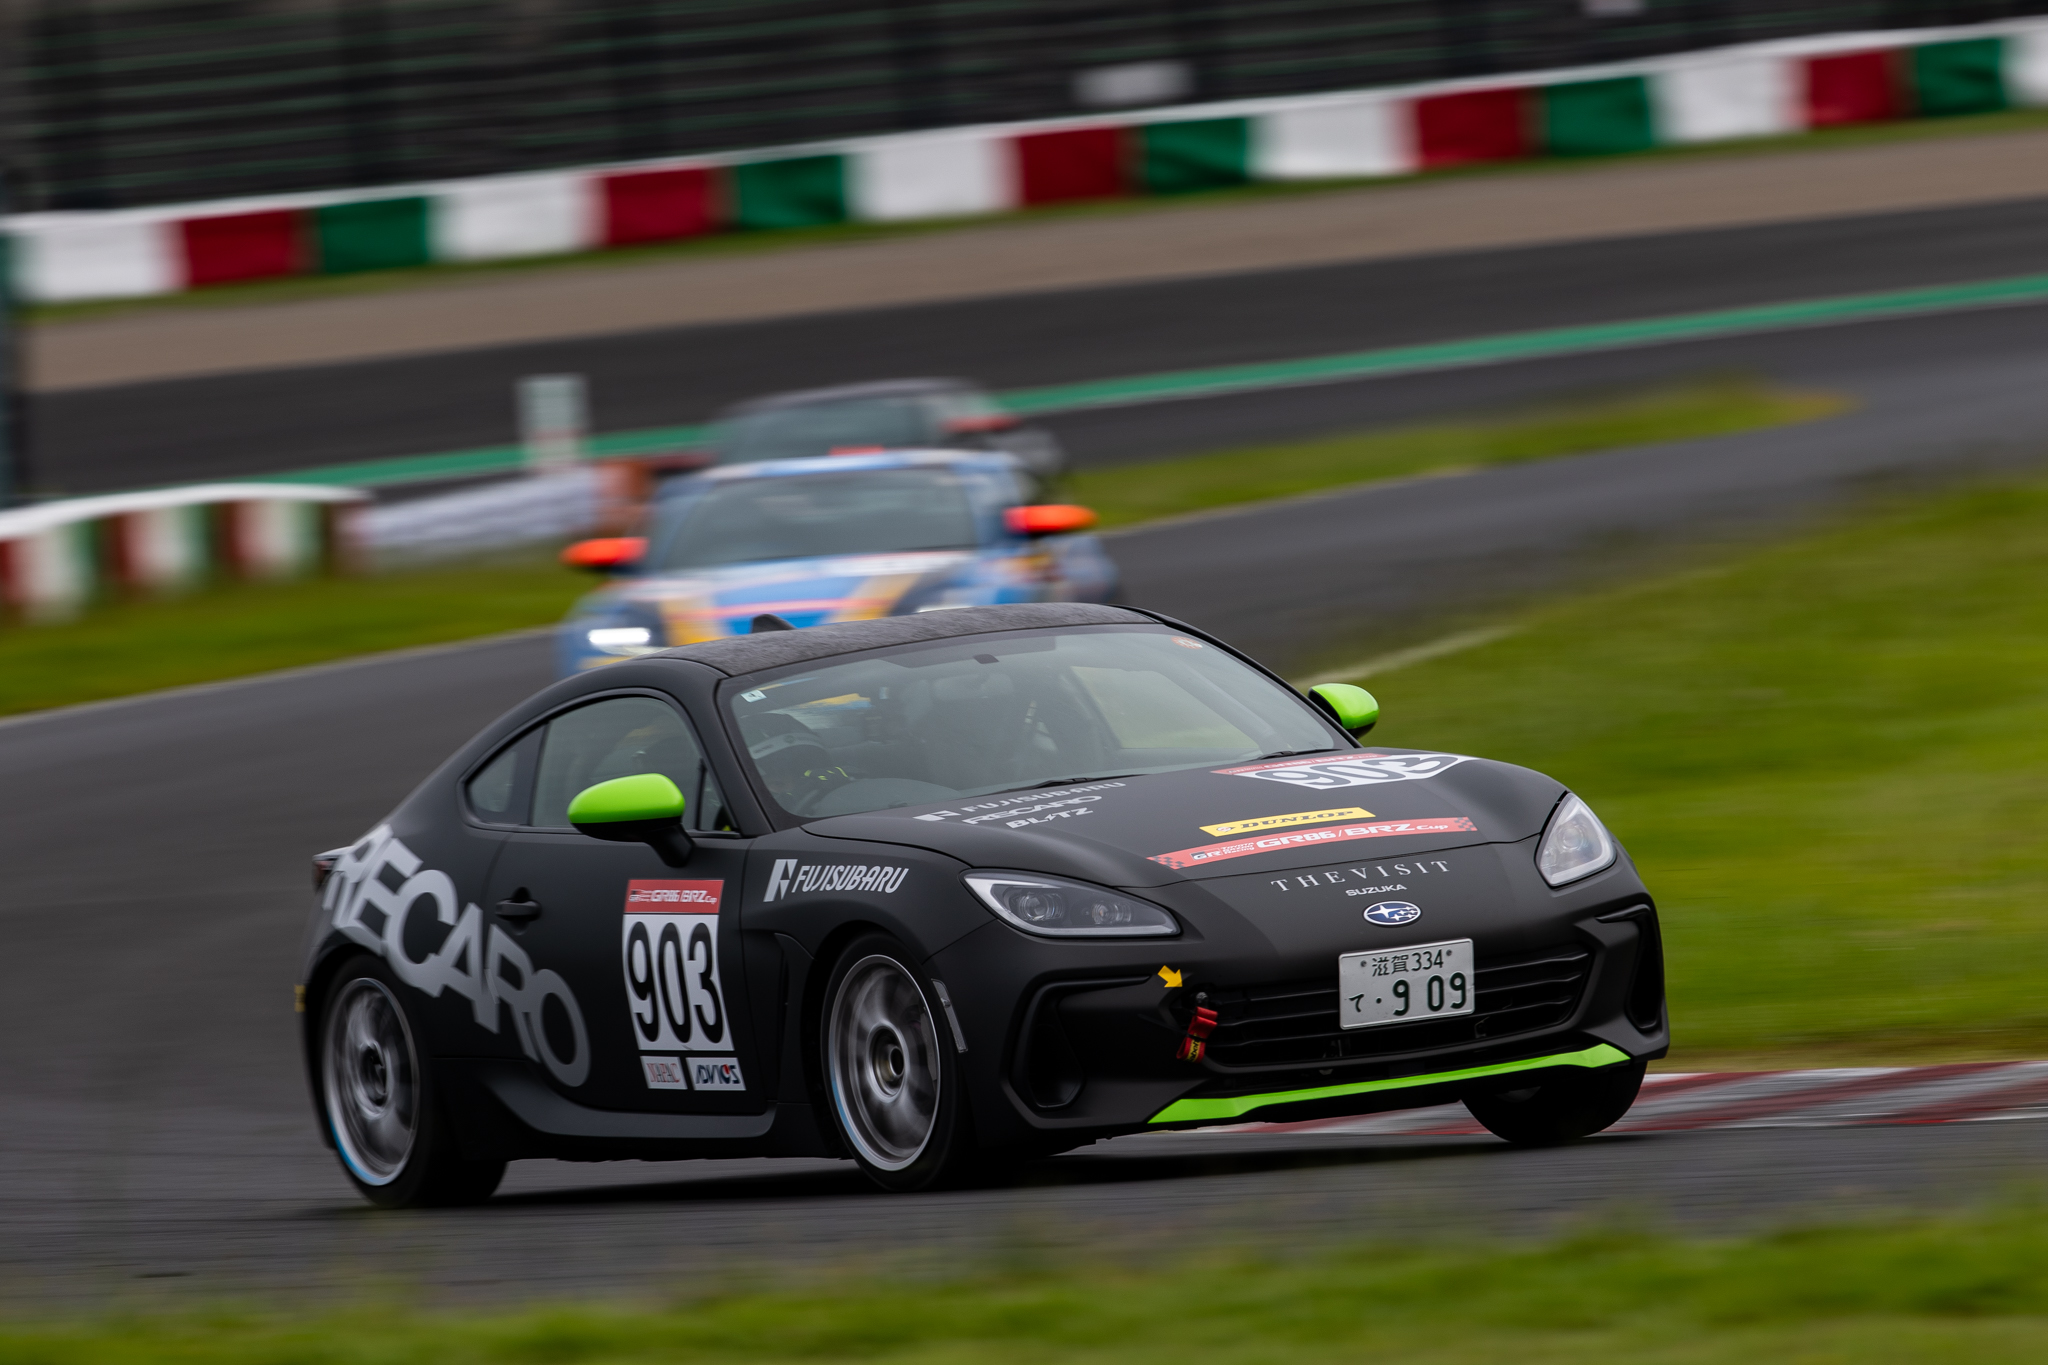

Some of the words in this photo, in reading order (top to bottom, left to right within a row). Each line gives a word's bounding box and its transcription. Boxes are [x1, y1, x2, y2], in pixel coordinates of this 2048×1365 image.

[1255, 756, 1458, 786] 903
[960, 782, 1126, 812] FUJISUBARU
[961, 795, 1102, 825] RECARO
[1005, 807, 1093, 829] BLITZ
[1240, 811, 1354, 829] DUNLOP
[791, 865, 909, 894] FUJISUBARU
[1345, 883, 1408, 897] SUZUKA
[321, 824, 591, 1087] RECARO
[627, 921, 724, 1044] 903
